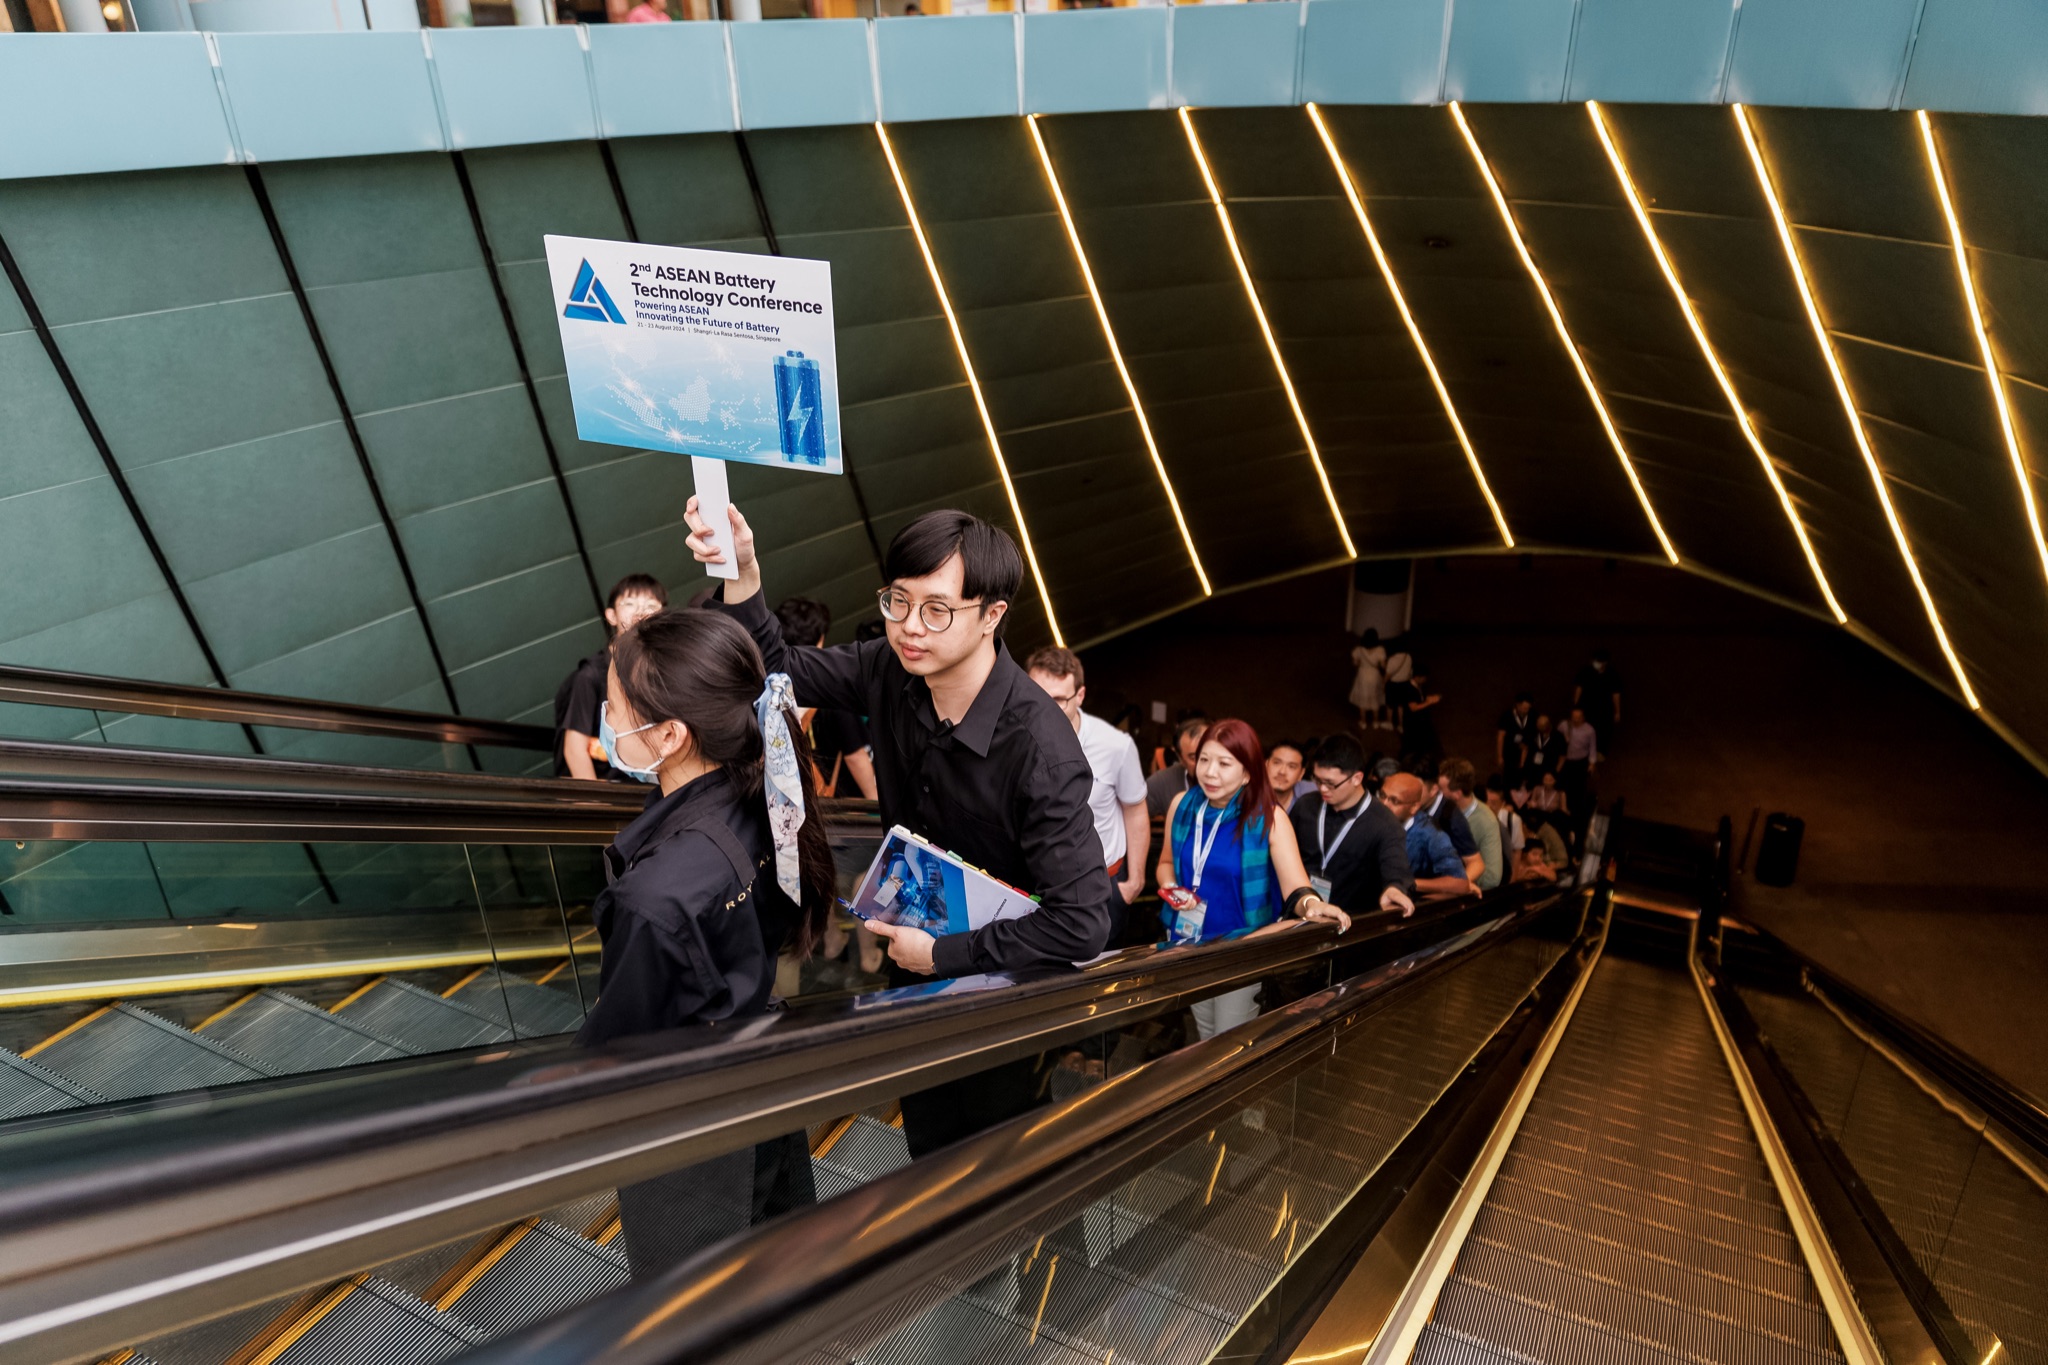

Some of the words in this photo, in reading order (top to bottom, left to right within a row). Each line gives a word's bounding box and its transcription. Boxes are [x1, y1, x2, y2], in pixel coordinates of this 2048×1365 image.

[630, 263, 651, 277] 2nd
[655, 266, 711, 284] ASEAN
[715, 272, 776, 293] Battery
[632, 282, 724, 307] Technology
[727, 292, 823, 315] Conference
[634, 300, 676, 314] Powering
[678, 305, 709, 316] ASEAN
[635, 310, 684, 325] Innovating
[686, 315, 701, 325] the
[703, 317, 733, 329] Future
[734, 320, 744, 330] of
[746, 322, 780, 335] Battery
[693, 328, 720, 336] Shangri-La
[755, 334, 781, 342] Singapore
